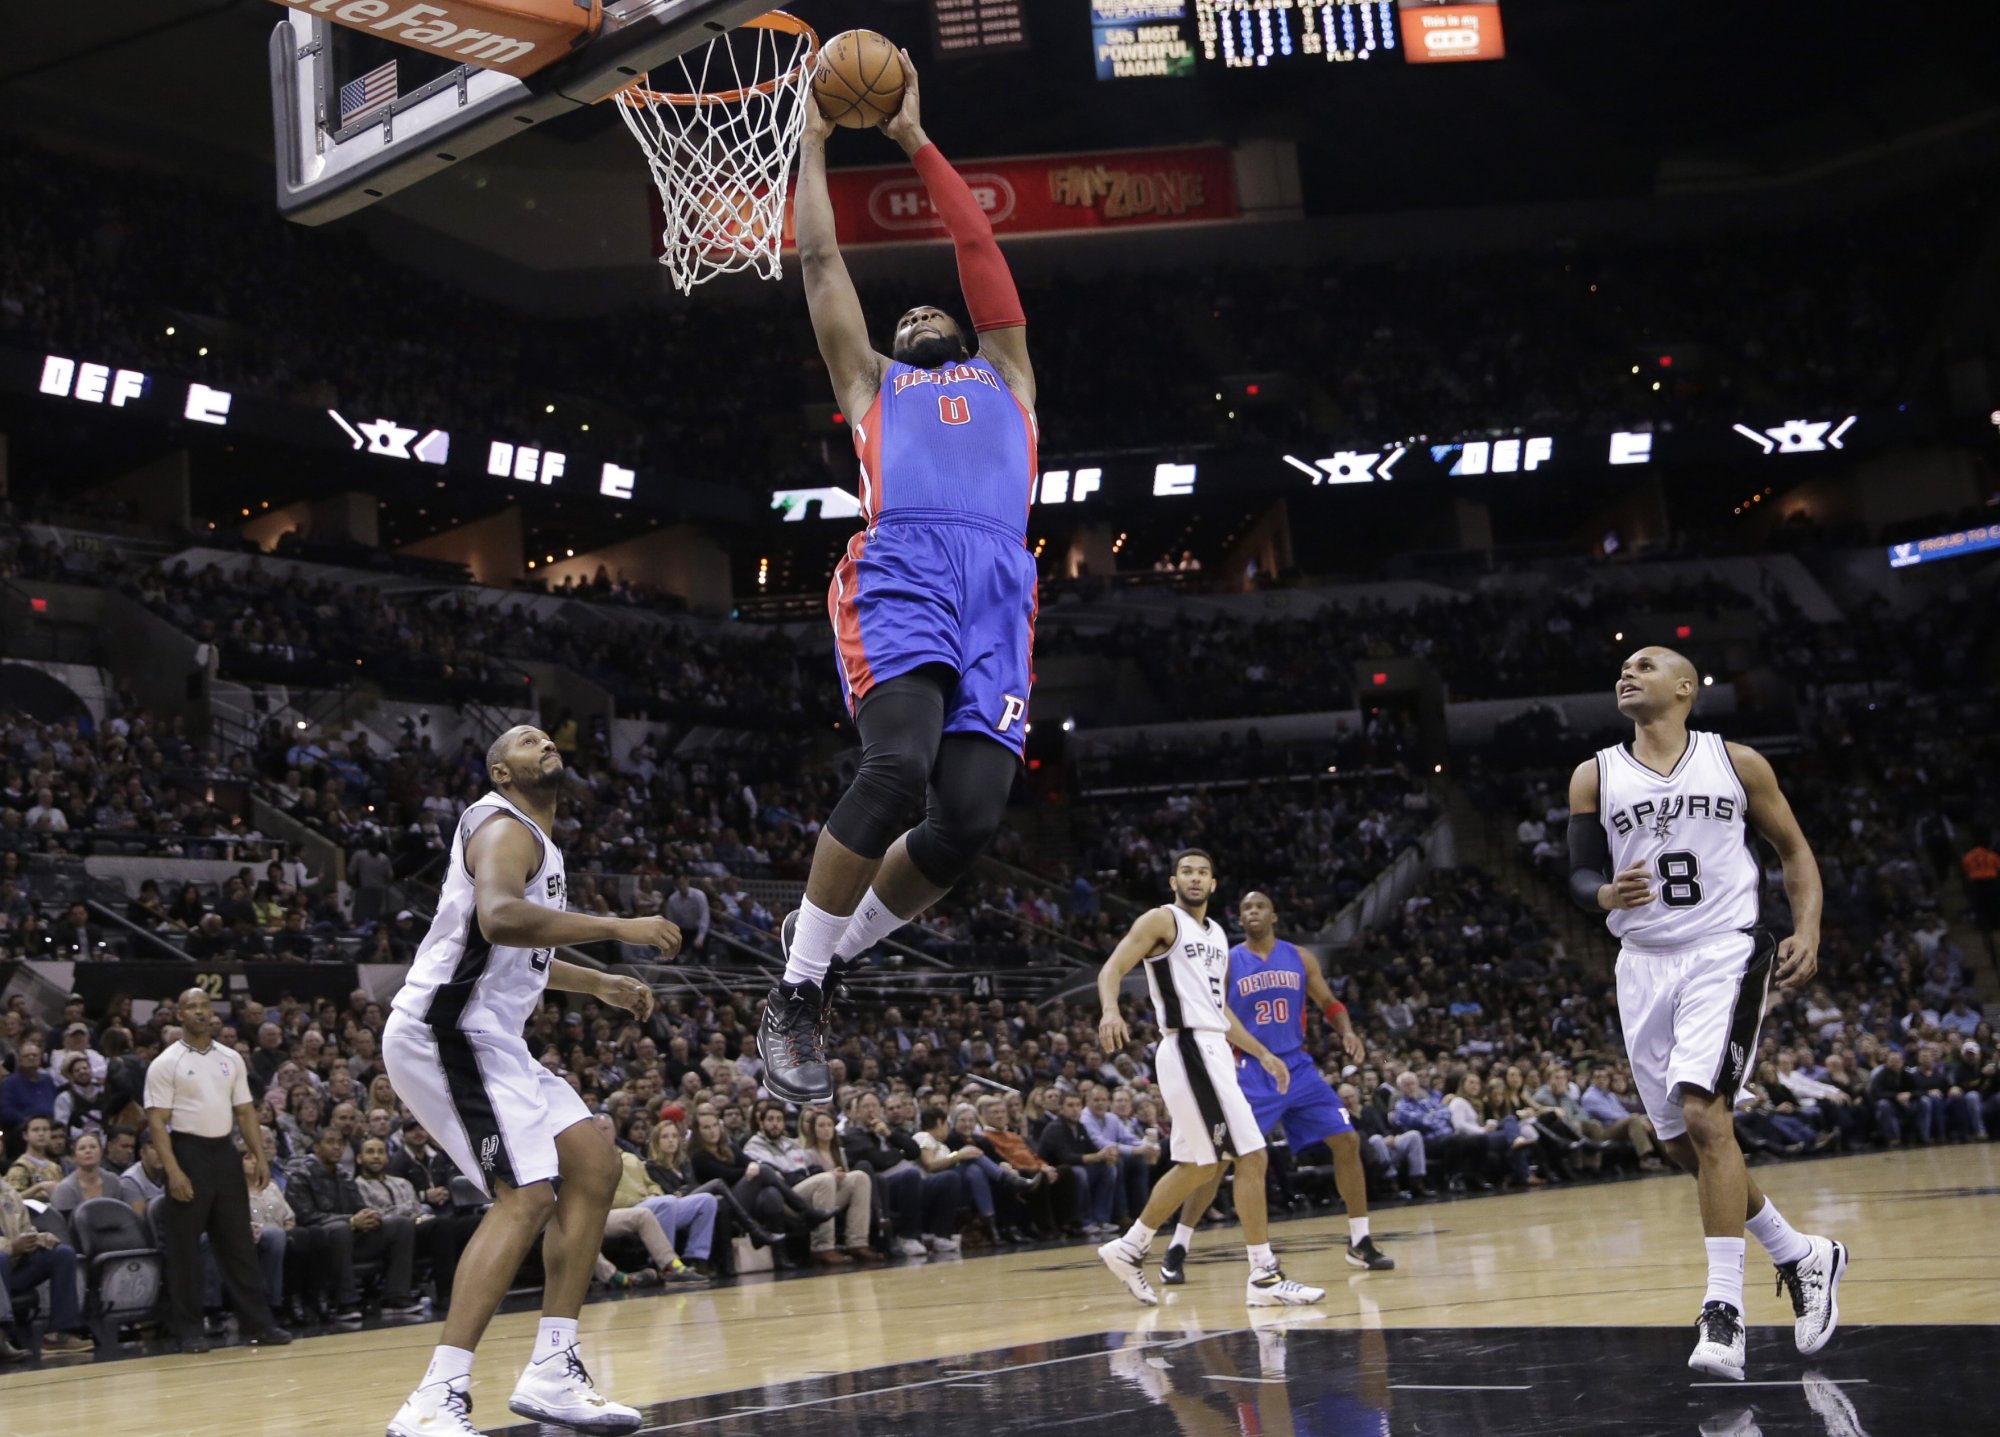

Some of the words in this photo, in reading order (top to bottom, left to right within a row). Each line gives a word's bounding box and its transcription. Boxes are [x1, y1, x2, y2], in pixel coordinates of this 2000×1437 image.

[1137, 25, 1180, 43] MOST
[1098, 40, 1192, 62] POWERFUL
[1113, 60, 1168, 77] RADAR
[894, 364, 1000, 395] DETROIT
[40, 356, 144, 407] DEF
[488, 441, 565, 485] DEF
[938, 395, 971, 425] 0
[1461, 437, 1553, 475] DEF
[1967, 528, 1987, 543] TO
[998, 694, 1025, 731] P
[1611, 795, 1735, 841] SPURS
[1655, 849, 1705, 908] 8
[1237, 970, 1301, 997] DETROIT
[1255, 998, 1289, 1025] 20
